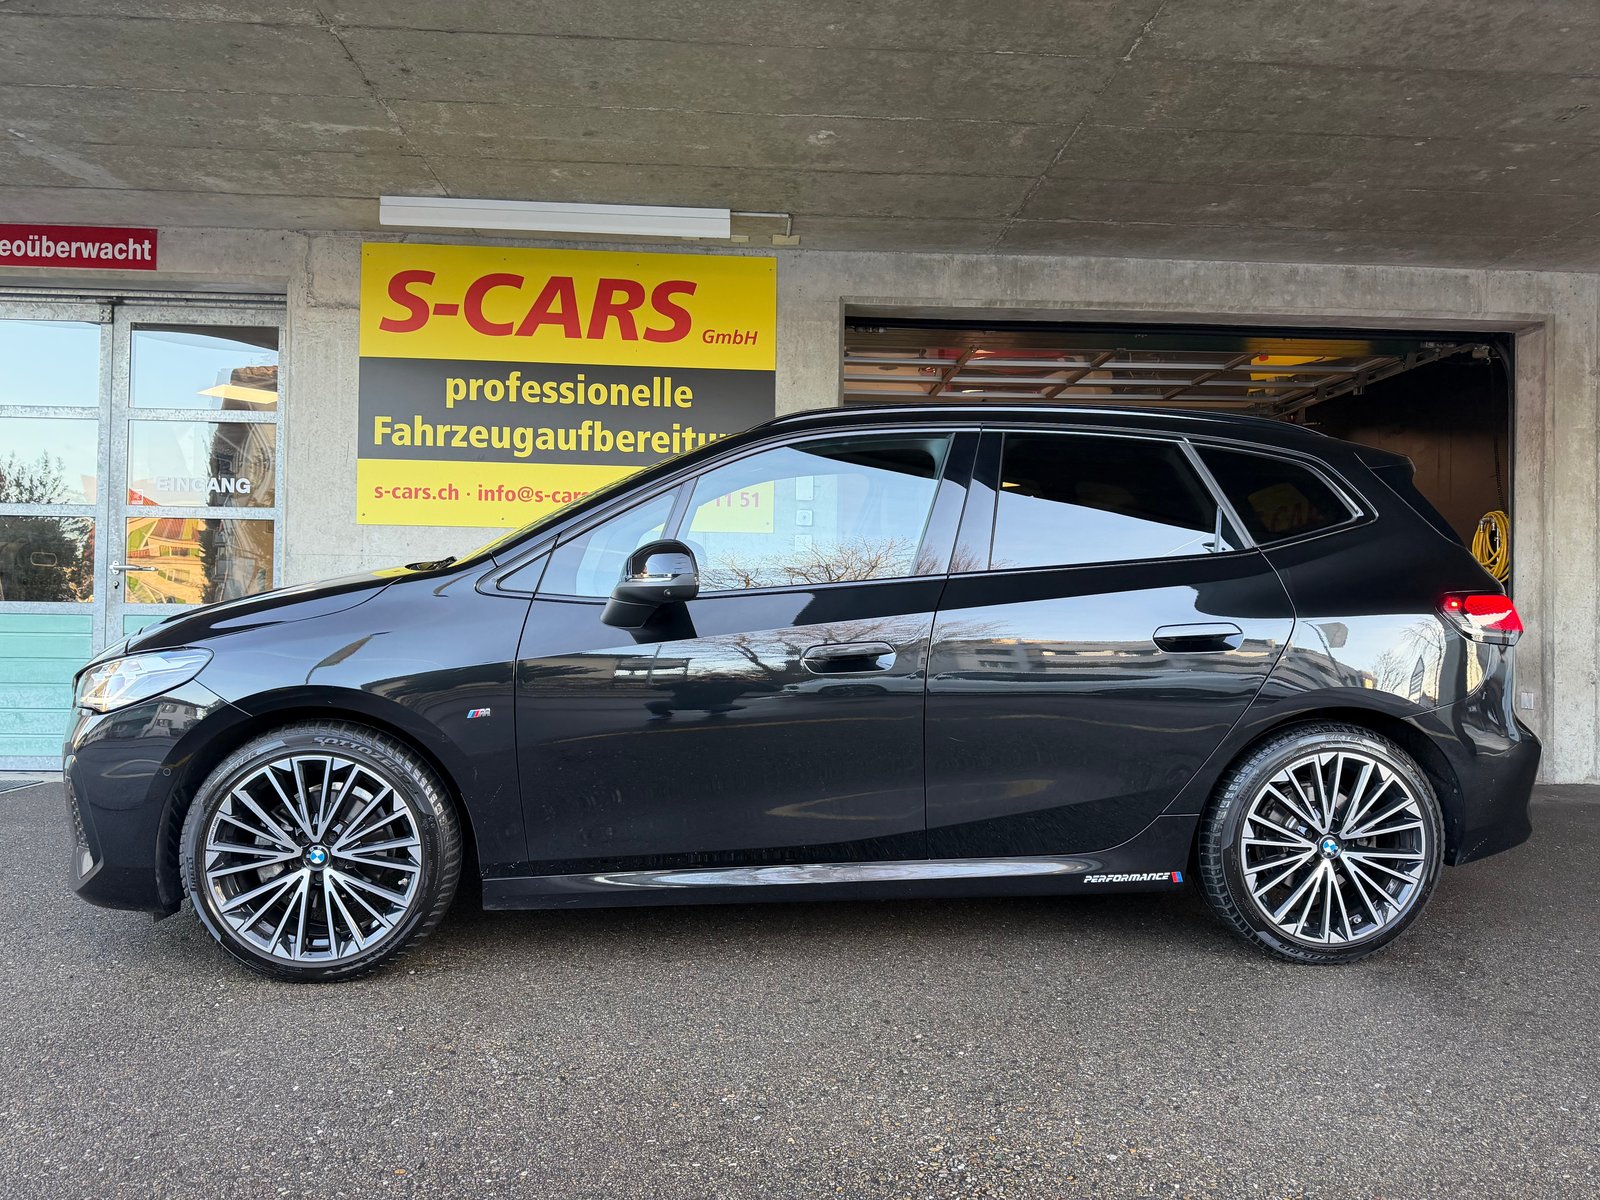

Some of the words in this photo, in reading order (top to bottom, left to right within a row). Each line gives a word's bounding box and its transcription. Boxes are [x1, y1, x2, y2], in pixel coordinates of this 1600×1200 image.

[0, 235, 152, 261] eoüberwacht
[379, 269, 698, 344] S-CARS
[702, 329, 758, 347] GmbH
[445, 371, 694, 409] professionelle
[157, 476, 252, 494] EINGANG
[374, 483, 460, 501] s-cars.ch
[740, 492, 760, 508] 51
[1083, 872, 1171, 884] PERFORMANCE
